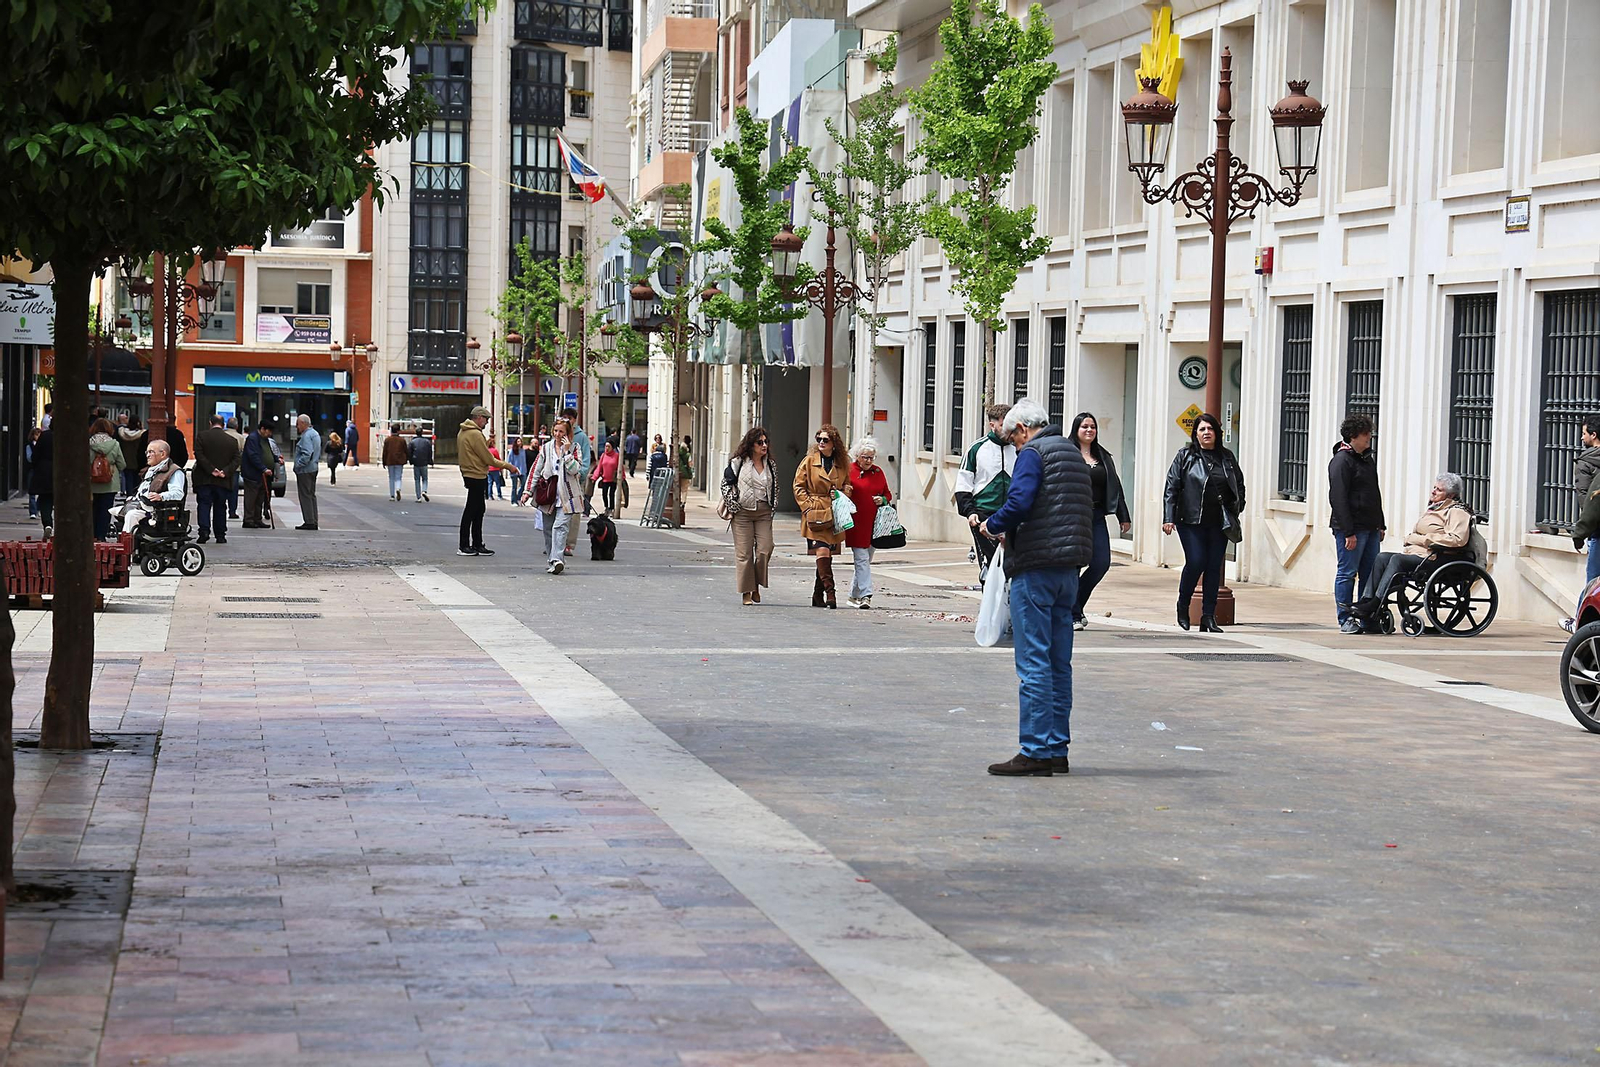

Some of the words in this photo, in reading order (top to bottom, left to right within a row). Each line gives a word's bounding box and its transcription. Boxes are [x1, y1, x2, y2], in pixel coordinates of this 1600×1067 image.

[811, 190, 855, 204] Casl
[21, 300, 55, 314] Ultra
[411, 376, 479, 391] Soloptical
